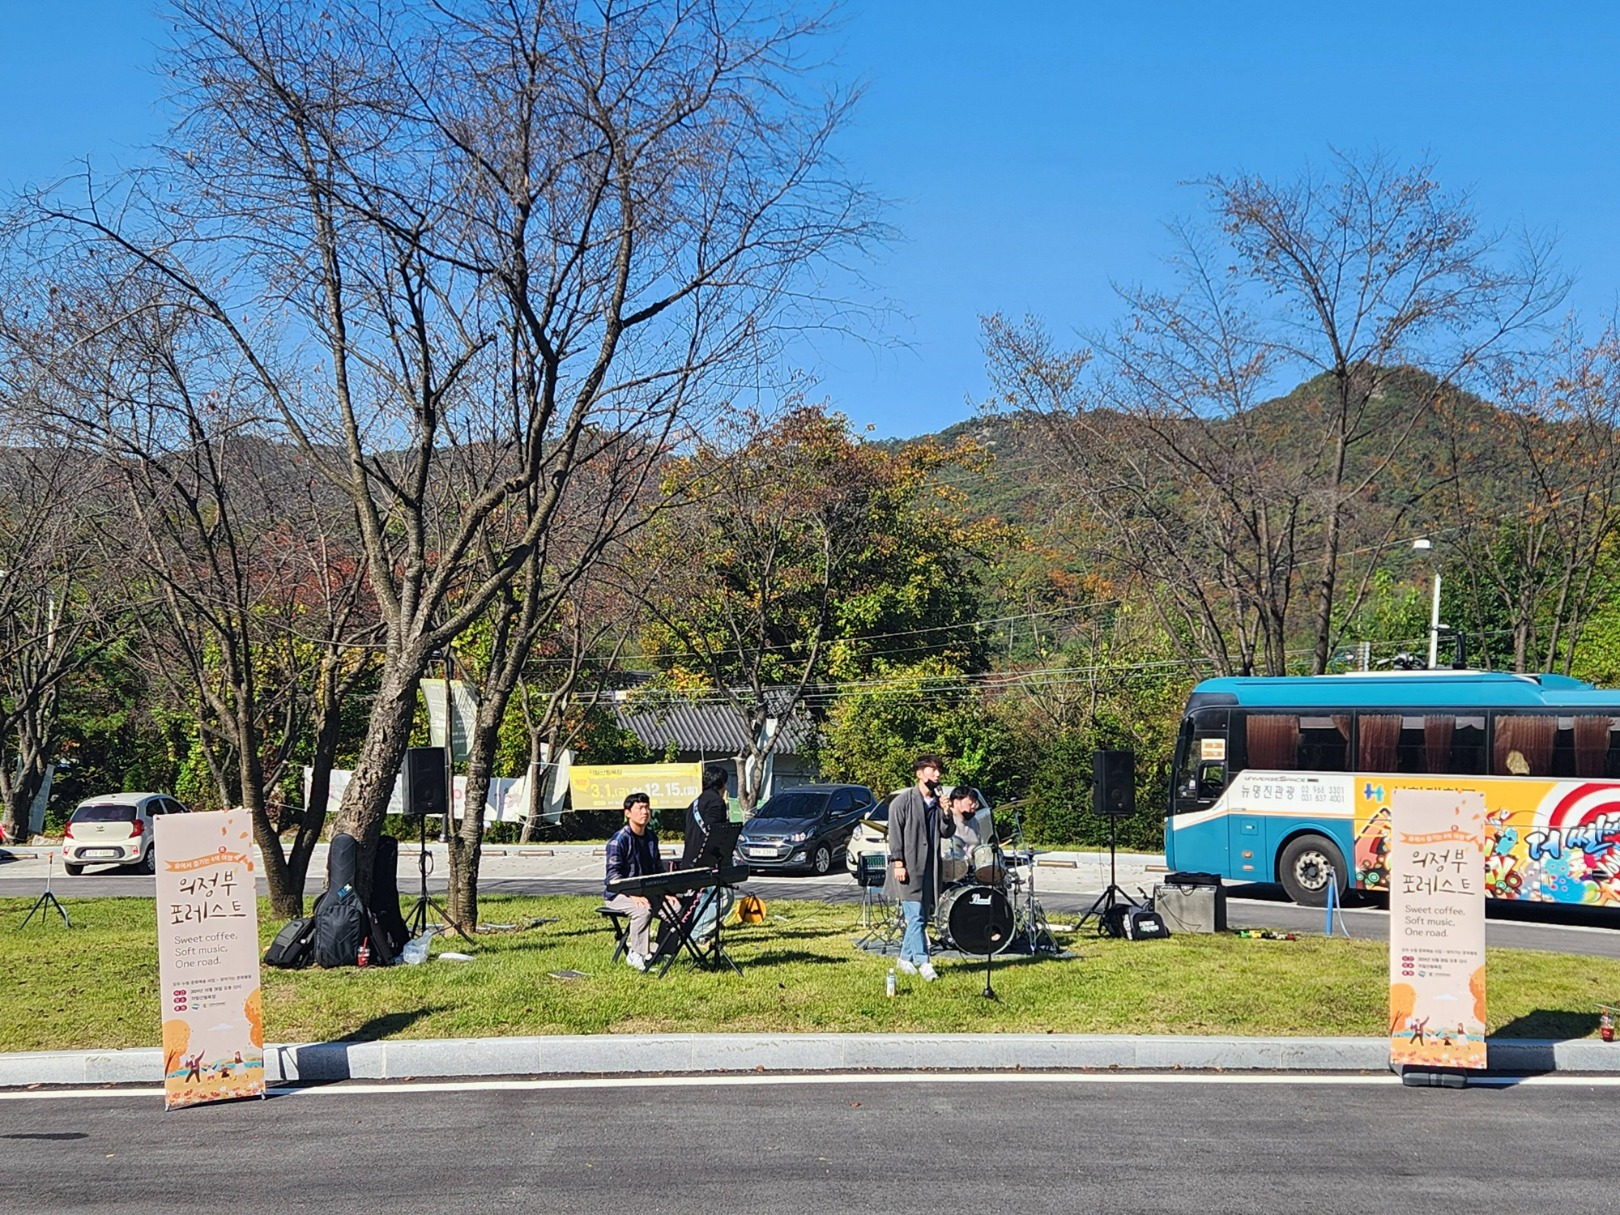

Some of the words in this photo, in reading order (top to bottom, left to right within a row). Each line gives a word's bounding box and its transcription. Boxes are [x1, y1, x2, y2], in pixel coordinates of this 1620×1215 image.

[1412, 849, 1468, 873] 의정부
[179, 870, 238, 897] 의정부
[1403, 874, 1475, 896] 포레스트
[170, 900, 247, 925] 포레스트
[1404, 905, 1432, 914] Sweet
[1404, 916, 1425, 925] Soft
[1404, 927, 1424, 936] One
[1425, 929, 1448, 937] road.
[174, 935, 203, 945] Sweet
[175, 947, 196, 957] Soft
[175, 959, 195, 969] One
[197, 956, 221, 967] road.
